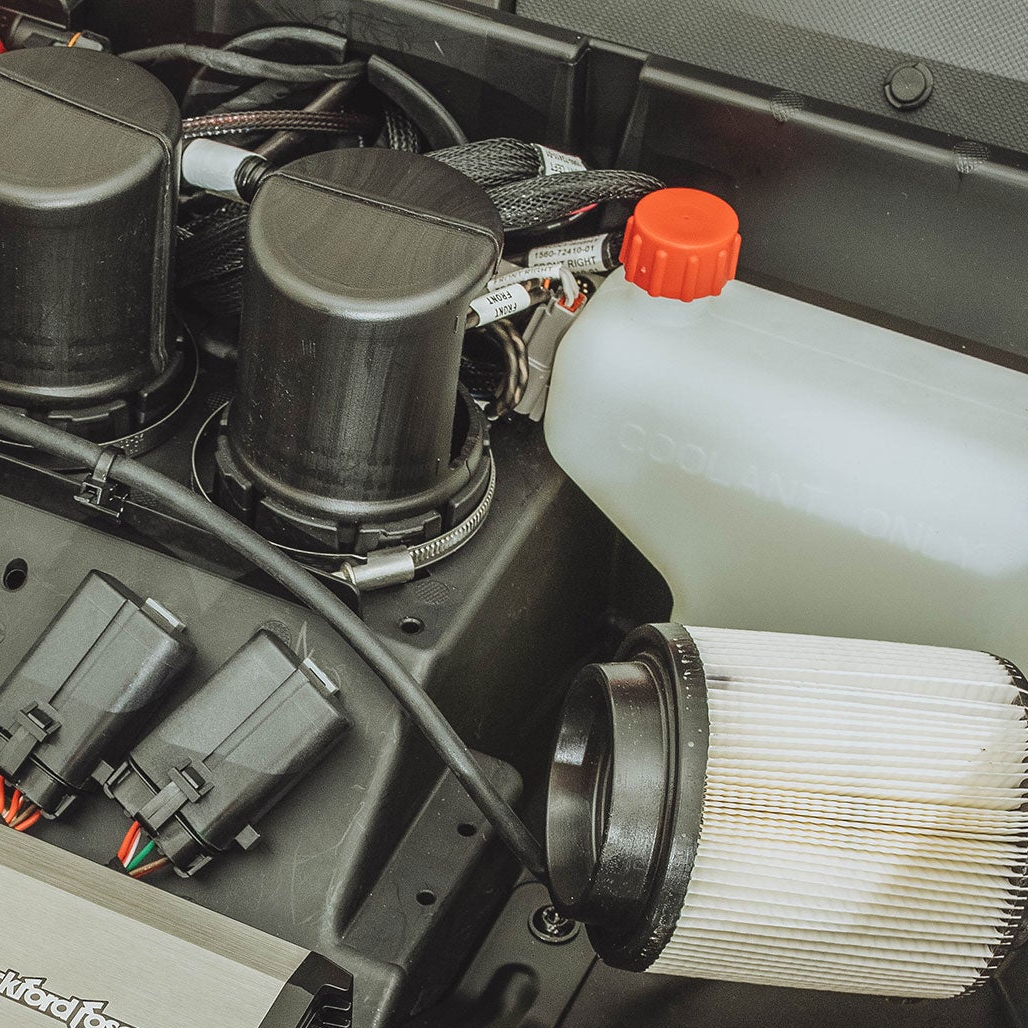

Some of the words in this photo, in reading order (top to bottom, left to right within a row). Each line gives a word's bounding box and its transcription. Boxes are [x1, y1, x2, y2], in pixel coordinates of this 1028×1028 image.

[567, 256, 596, 269] RIGHT
[486, 290, 512, 305] FRONT
[493, 303, 518, 317] FRONT
[618, 422, 829, 515] COOLANT
[858, 507, 986, 569] ONLY
